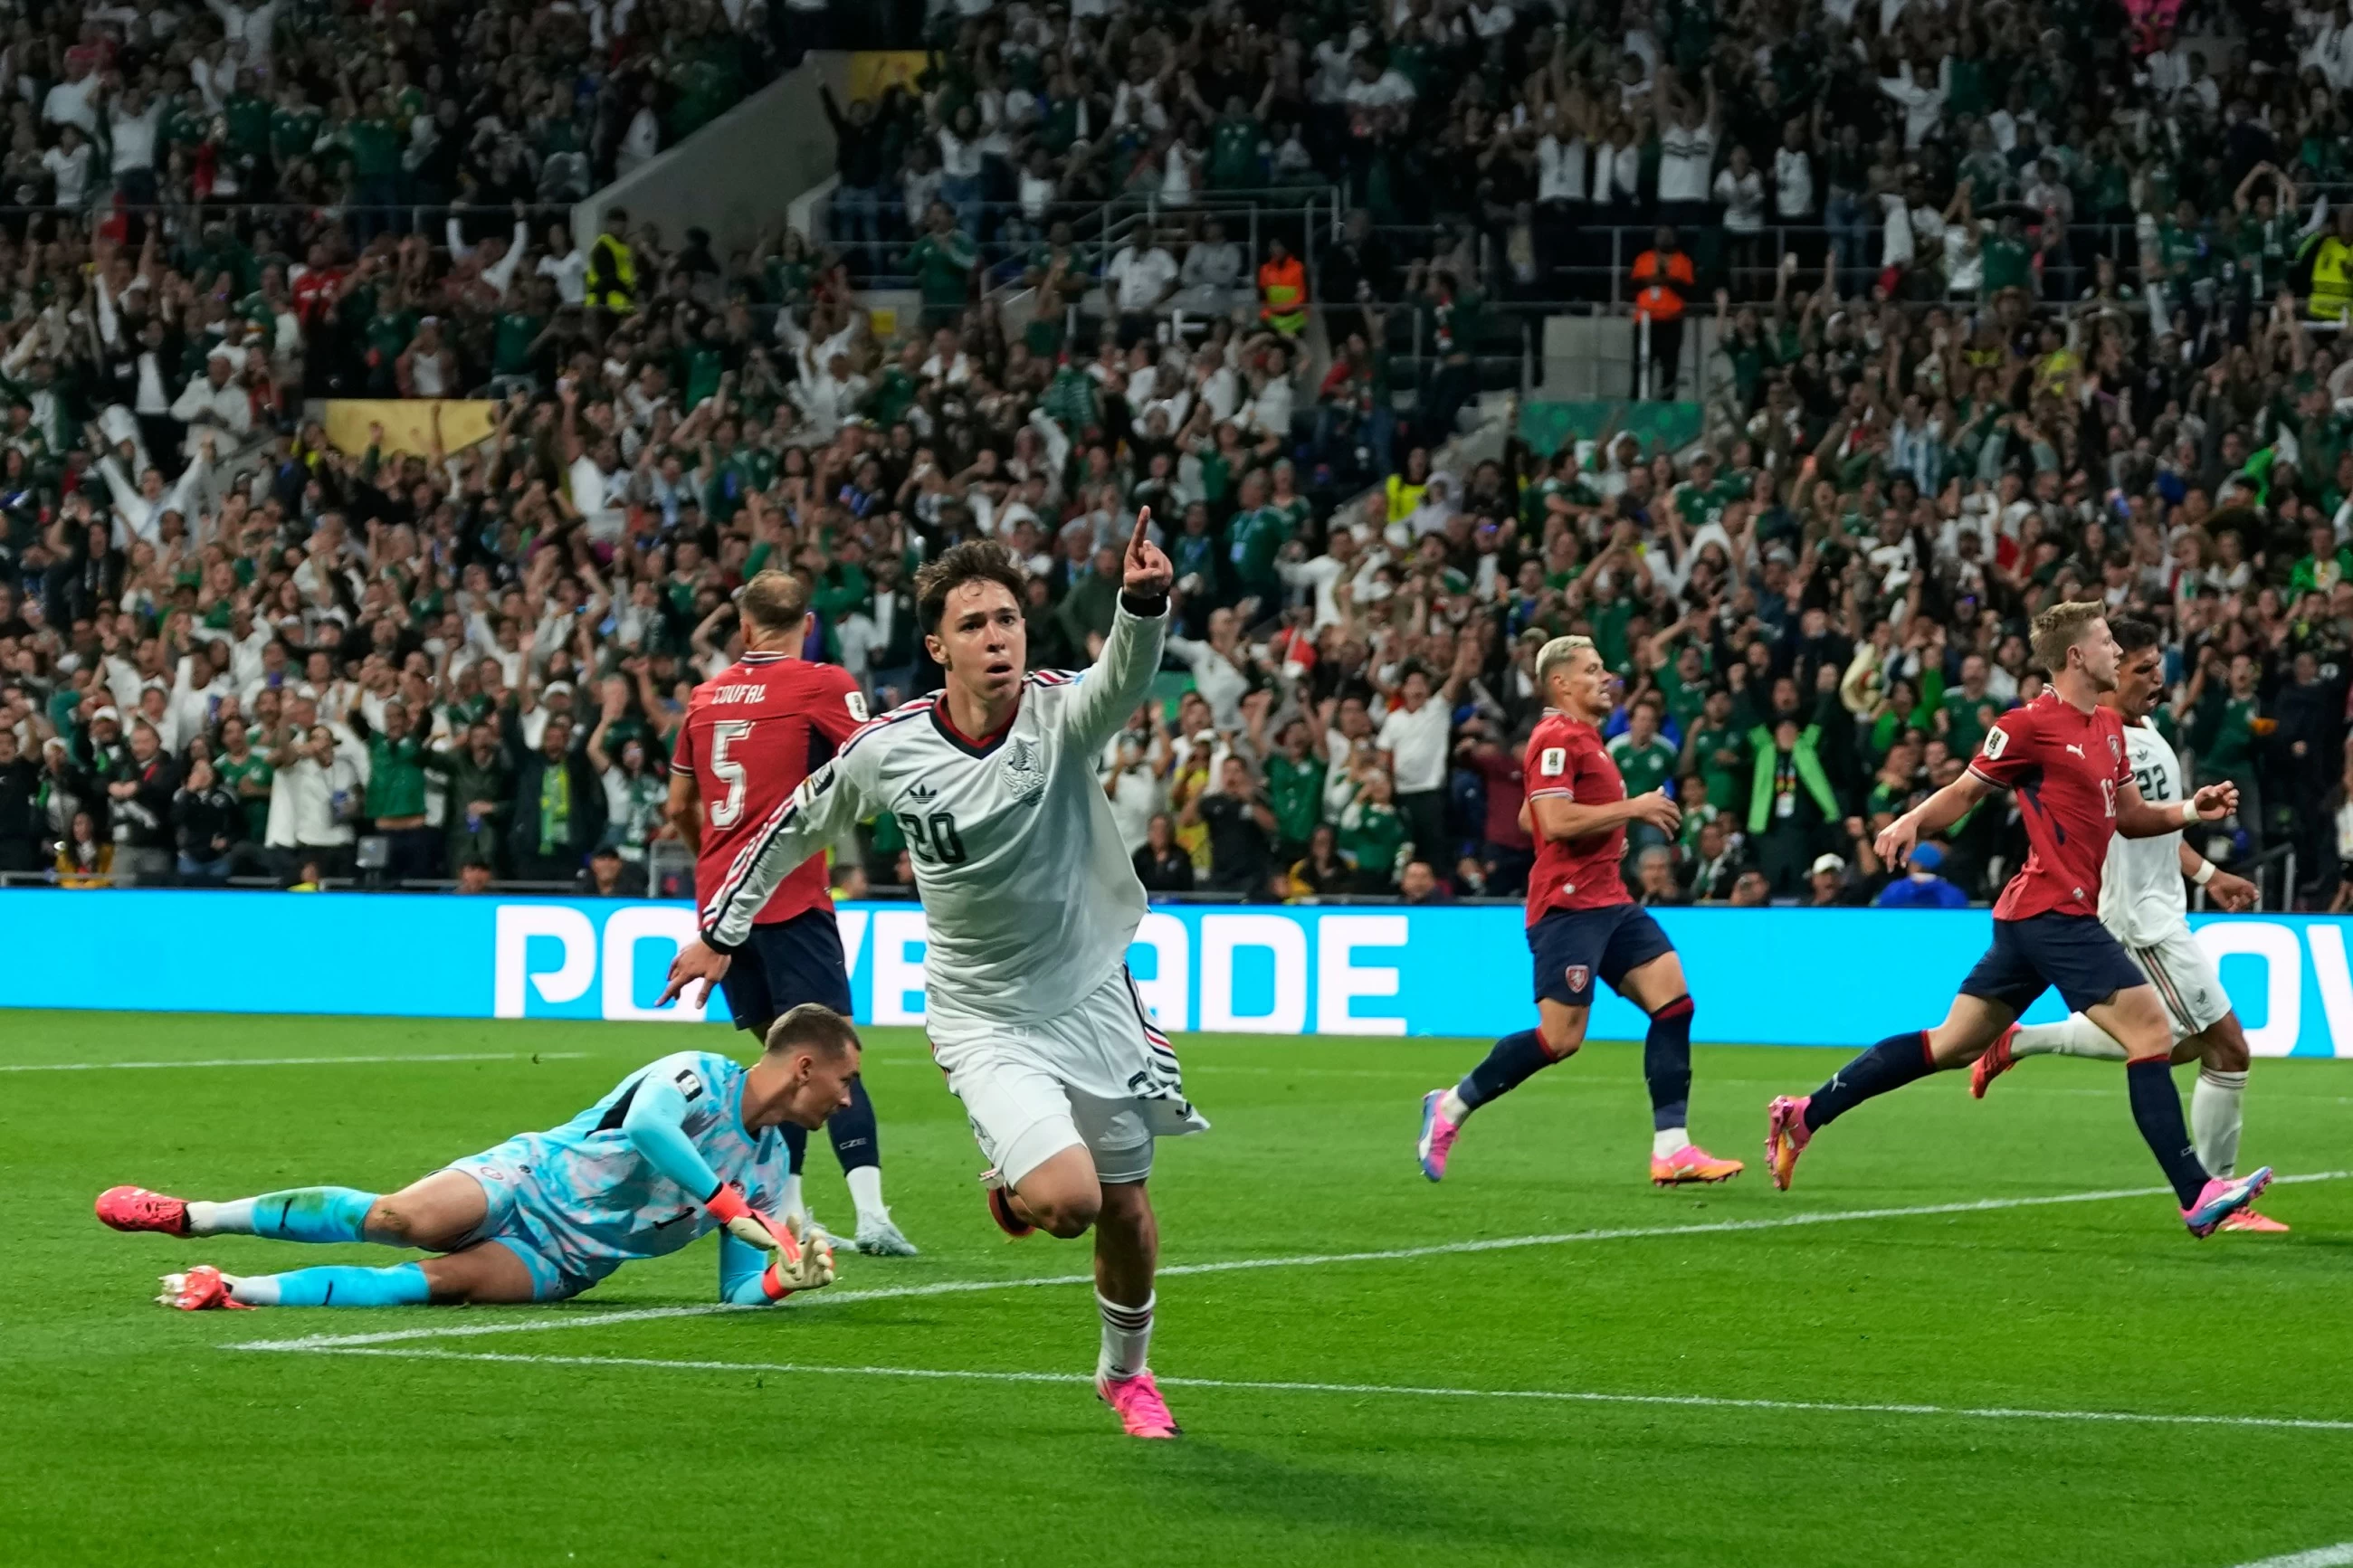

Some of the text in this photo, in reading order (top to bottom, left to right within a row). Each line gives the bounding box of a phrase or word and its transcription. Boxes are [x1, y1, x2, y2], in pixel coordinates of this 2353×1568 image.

[710, 719, 757, 830] 5
[2136, 763, 2170, 801] 22
[900, 813, 967, 864] 20
[493, 904, 1409, 1036] POEADE
[839, 1136, 867, 1150] CZE
